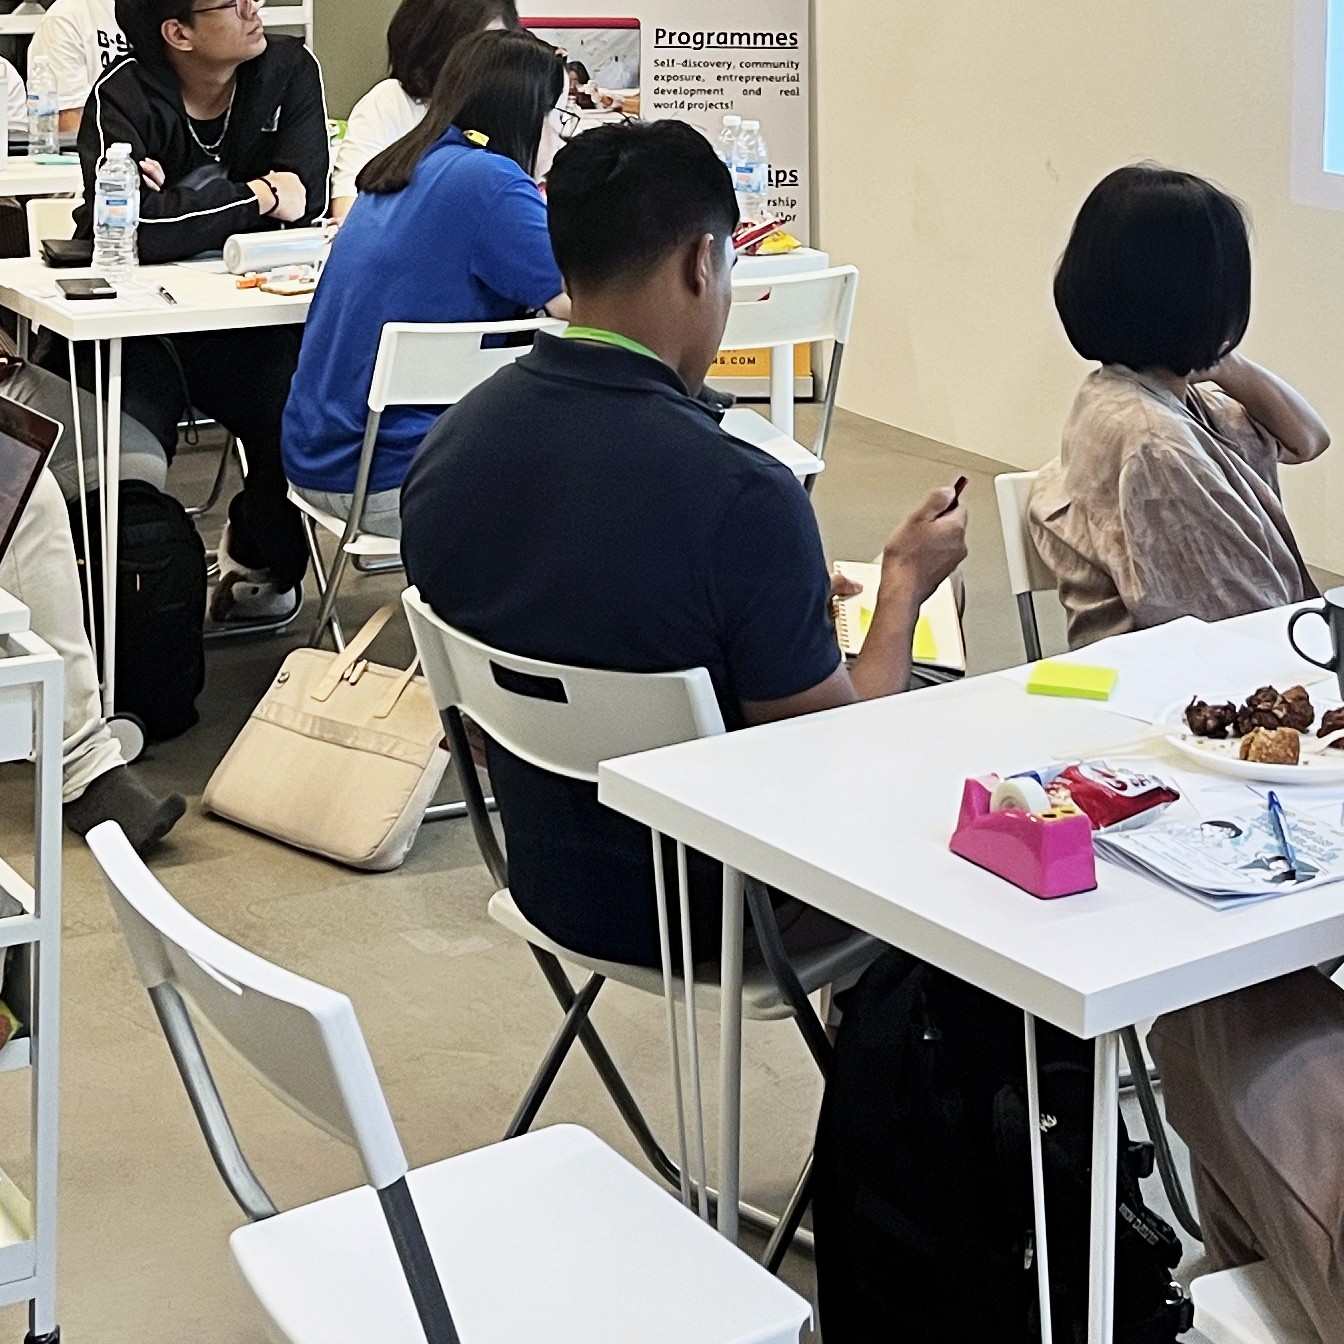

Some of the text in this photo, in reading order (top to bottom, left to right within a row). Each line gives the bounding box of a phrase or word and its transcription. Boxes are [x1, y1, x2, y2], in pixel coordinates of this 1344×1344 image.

[655, 28, 799, 51] Programmes
[653, 58, 800, 70] Self-discovery, community
[653, 73, 800, 84] exposure, entrepreneurial
[653, 86, 800, 98] development and real
[653, 100, 734, 112] world projects!
